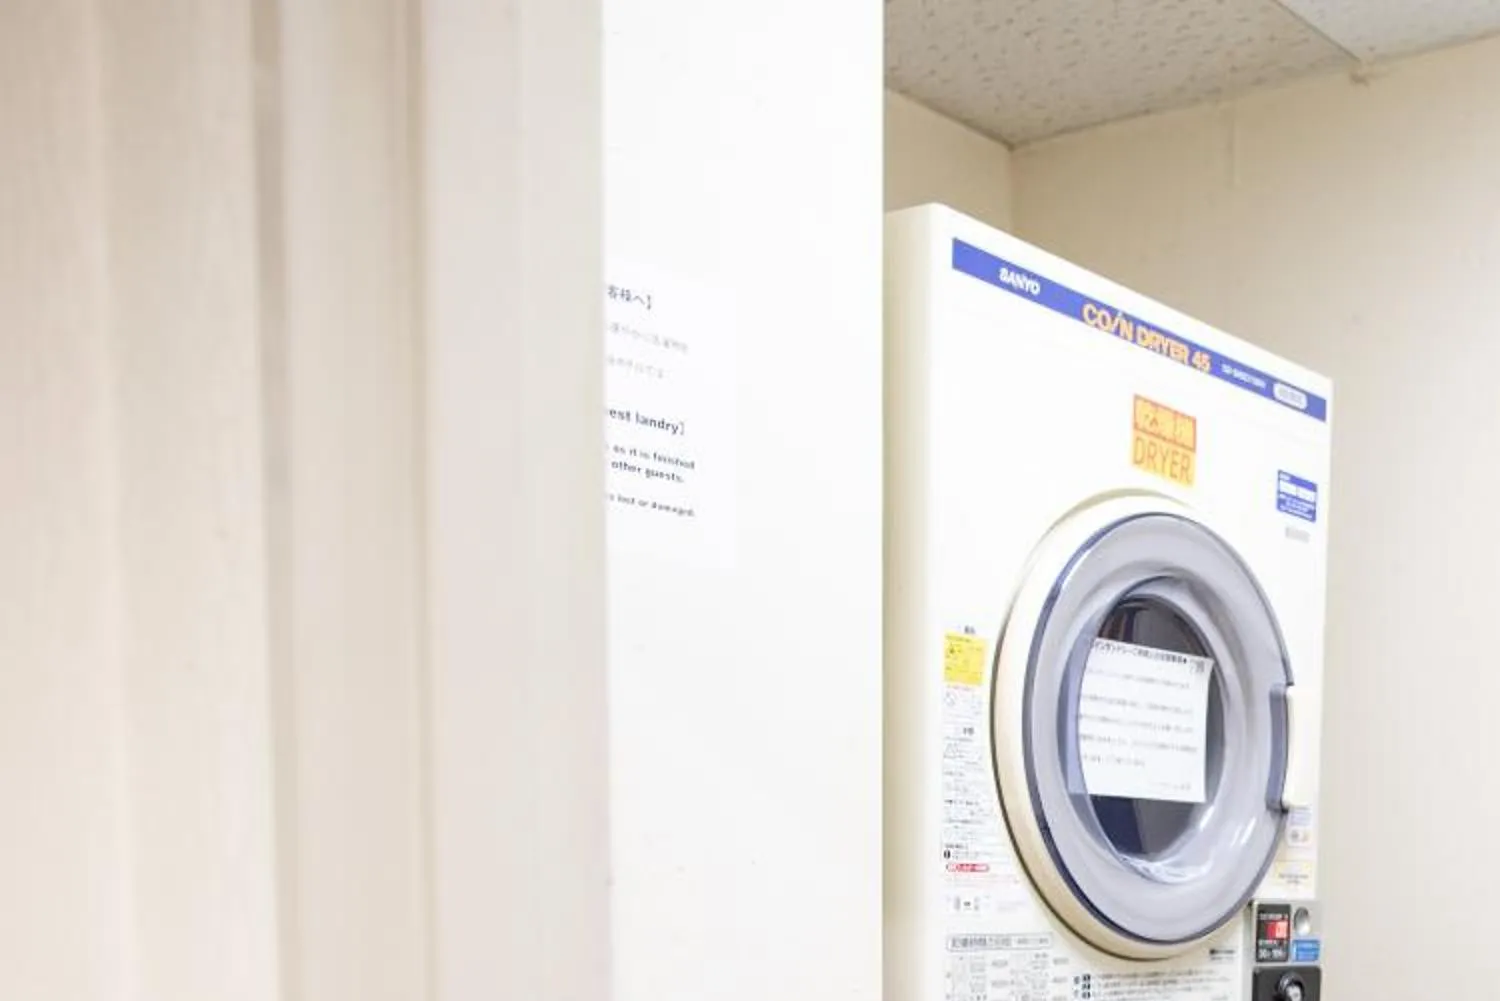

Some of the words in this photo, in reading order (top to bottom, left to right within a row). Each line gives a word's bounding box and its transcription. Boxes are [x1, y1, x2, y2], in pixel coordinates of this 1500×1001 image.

[1000, 268, 1041, 296] SANYO
[1136, 327, 1189, 365] DRYER
[608, 409, 631, 422] est
[1134, 435, 1192, 485] DRYER
